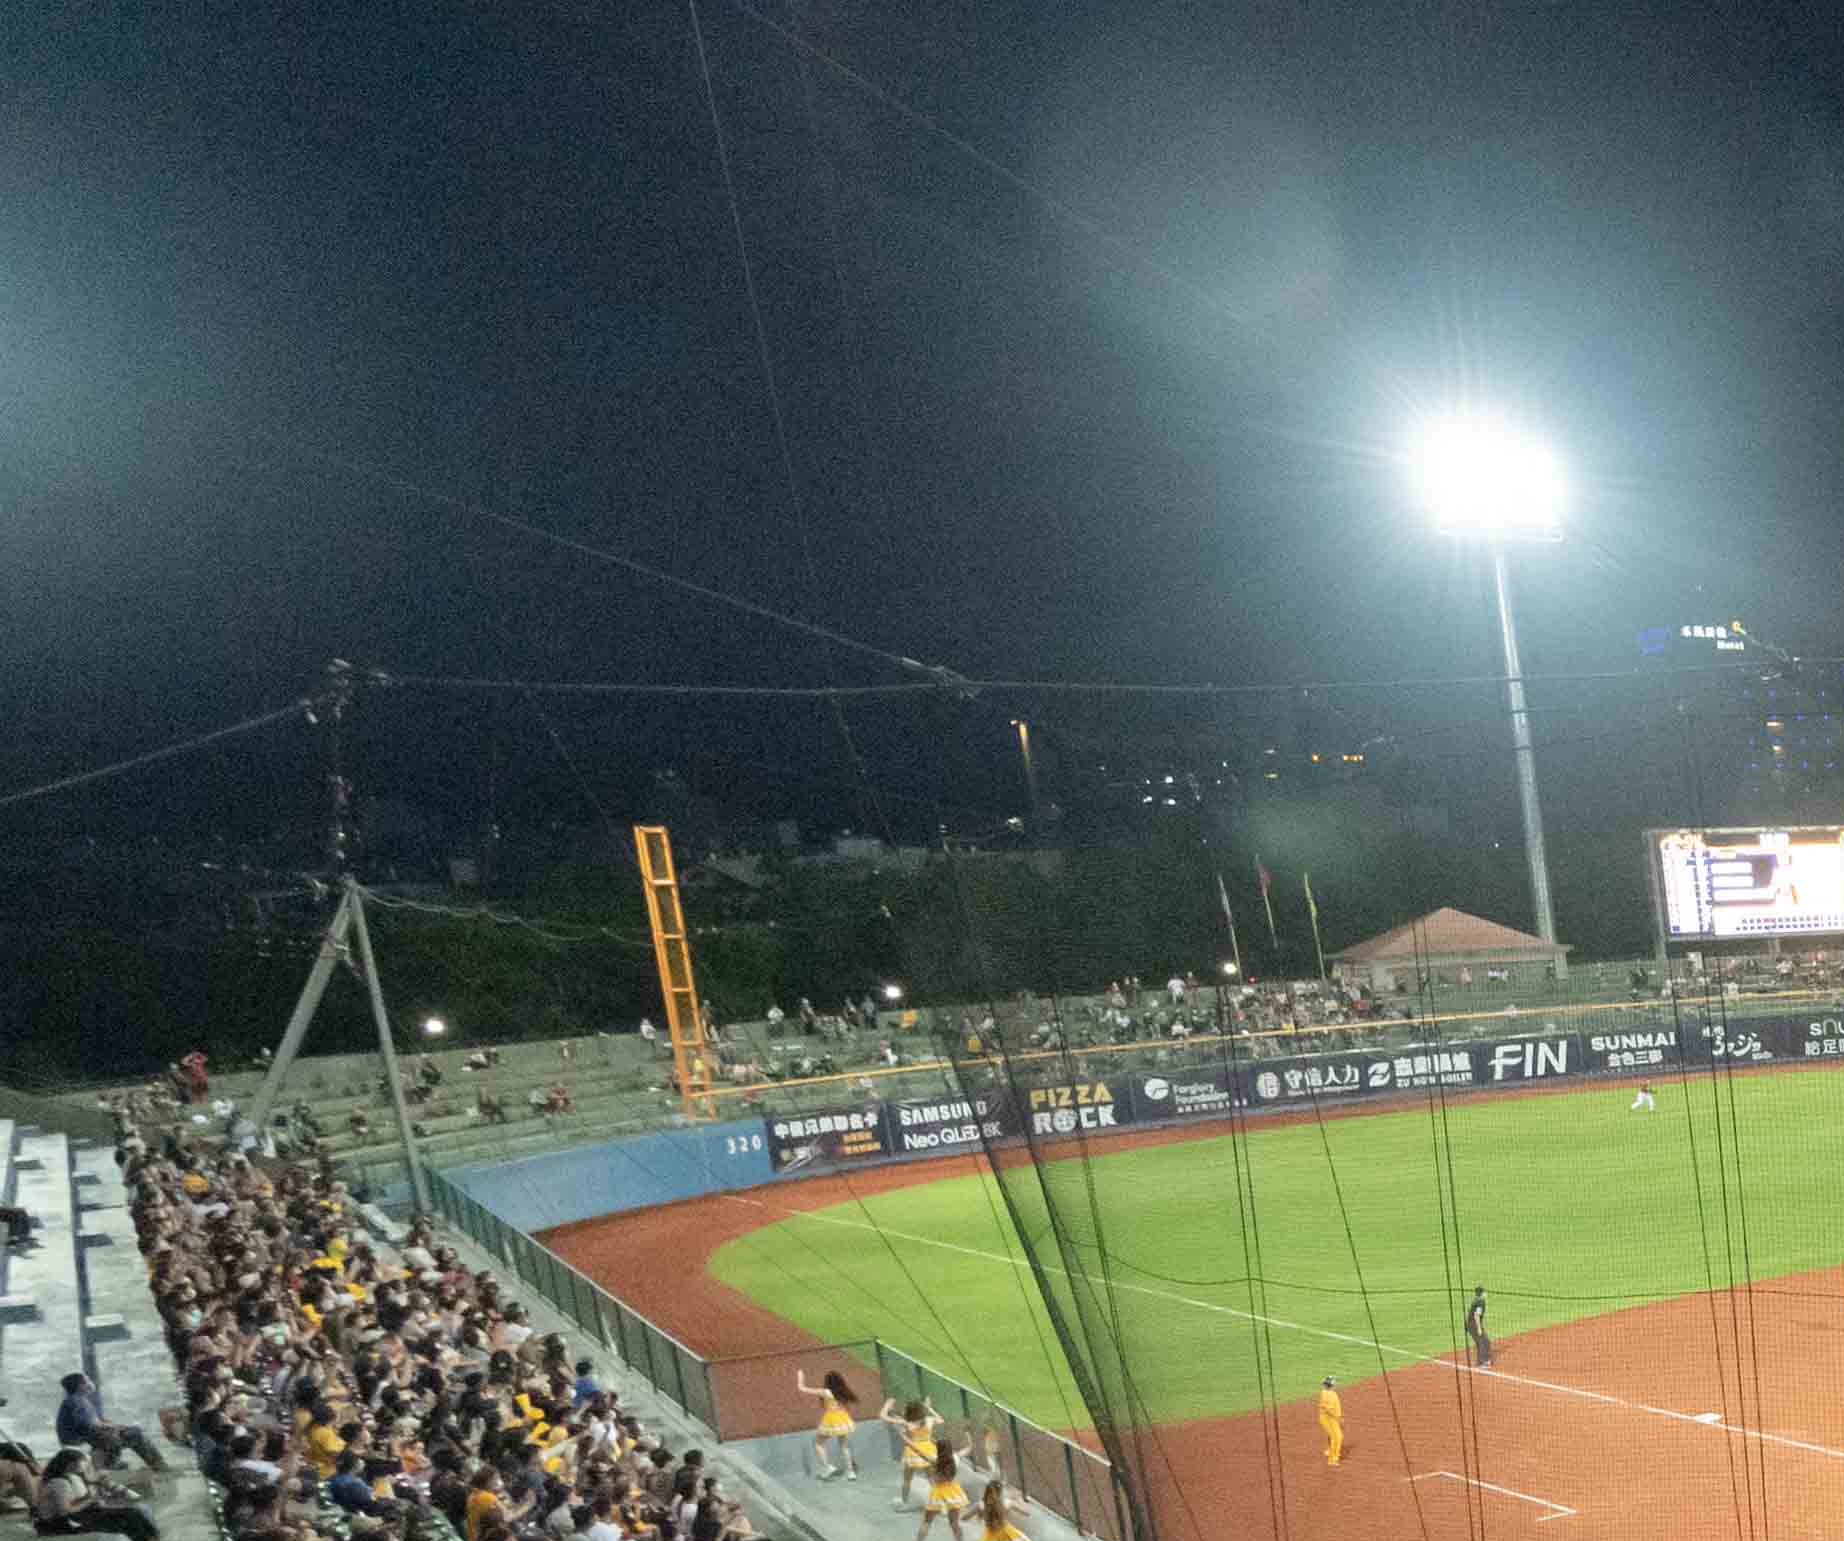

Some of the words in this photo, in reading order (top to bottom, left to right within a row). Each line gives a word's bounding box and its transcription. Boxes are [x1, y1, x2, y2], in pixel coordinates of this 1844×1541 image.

[1591, 1031, 1676, 1051] SUNMAI
[1488, 1040, 1568, 1081] FIN
[1284, 1064, 1360, 1089] 守信人力
[1029, 1080, 1114, 1110] PIZZA
[1032, 1104, 1119, 1135] ROCK
[727, 1134, 762, 1155] 320
[904, 1132, 938, 1151] Neo
[940, 1124, 980, 1145] QLED
